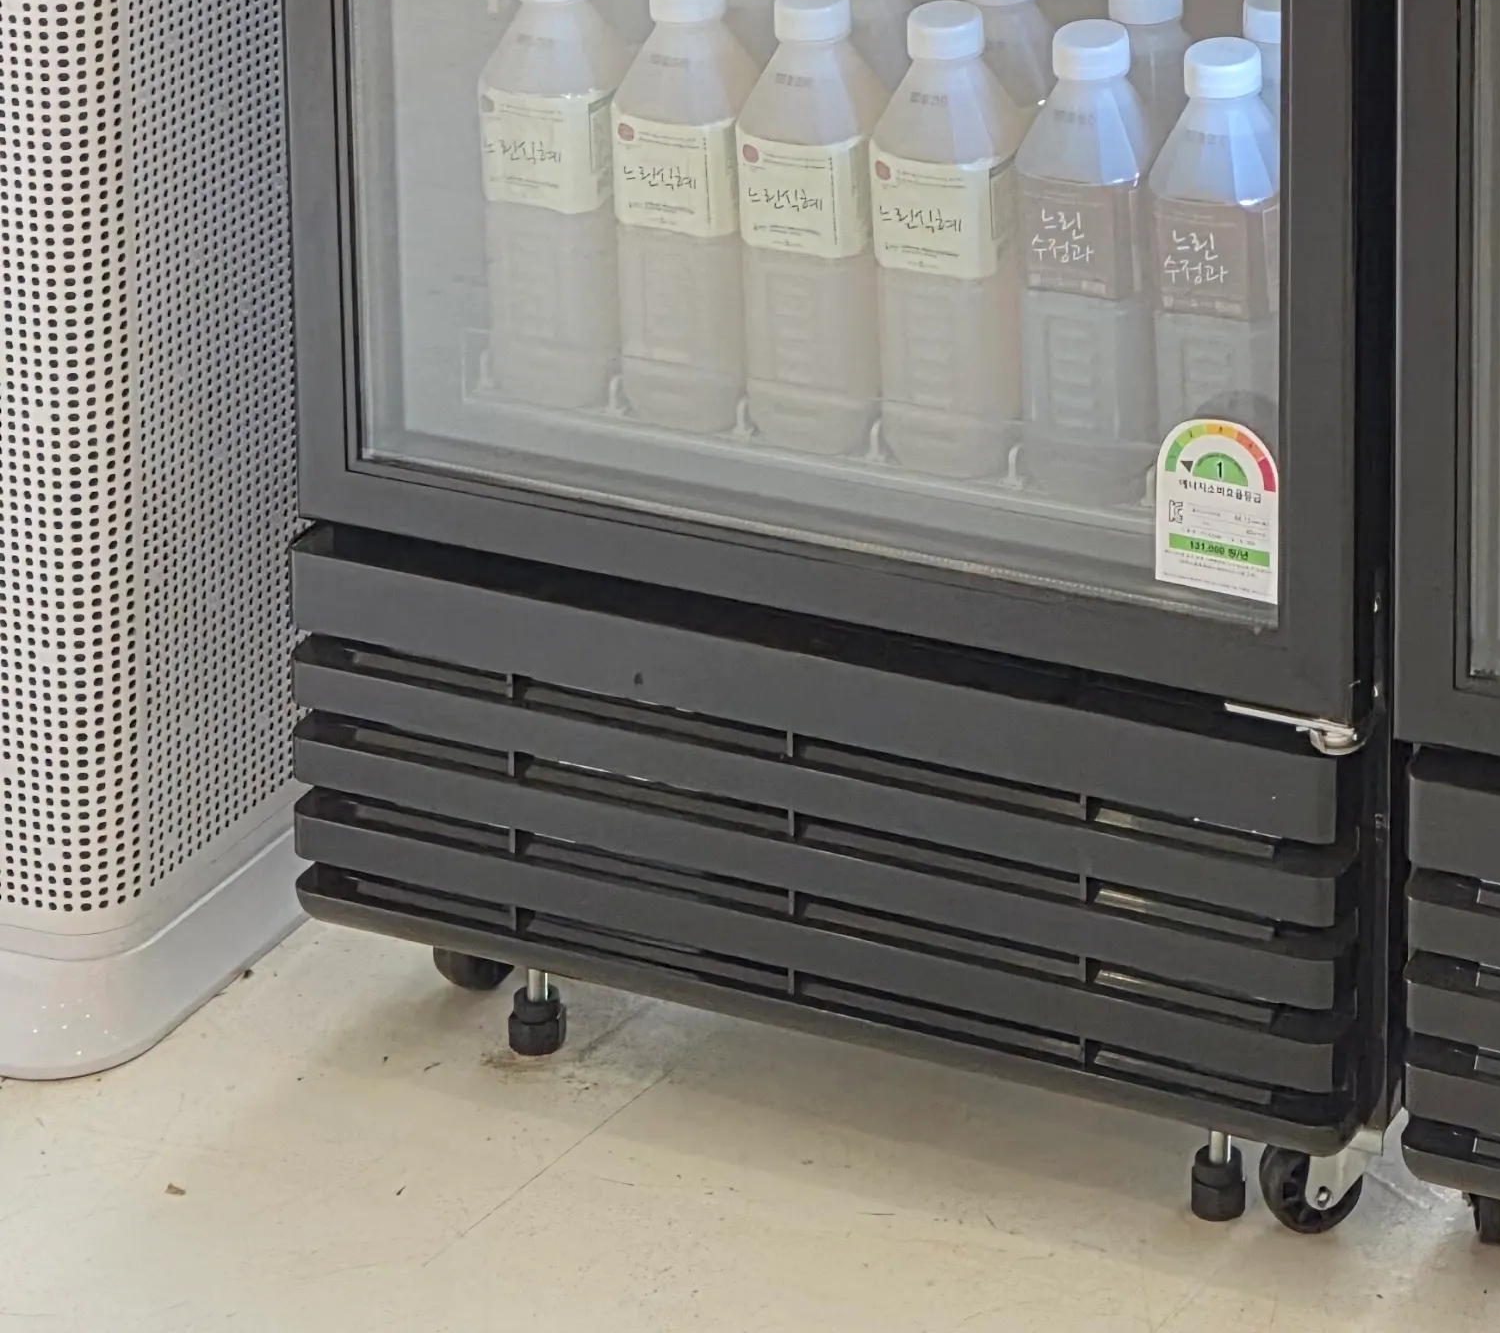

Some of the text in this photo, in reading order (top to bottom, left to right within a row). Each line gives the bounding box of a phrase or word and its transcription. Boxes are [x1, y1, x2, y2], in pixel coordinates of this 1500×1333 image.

[622, 163, 697, 191] 느린식혜
[747, 186, 823, 212] 느린식혜
[879, 202, 962, 234] 느린식혜
[1041, 207, 1085, 240] 느린
[1031, 233, 1094, 264] 수정과
[1171, 229, 1217, 261] 느린
[1164, 252, 1229, 287] 수정과
[1215, 460, 1223, 479] 1
